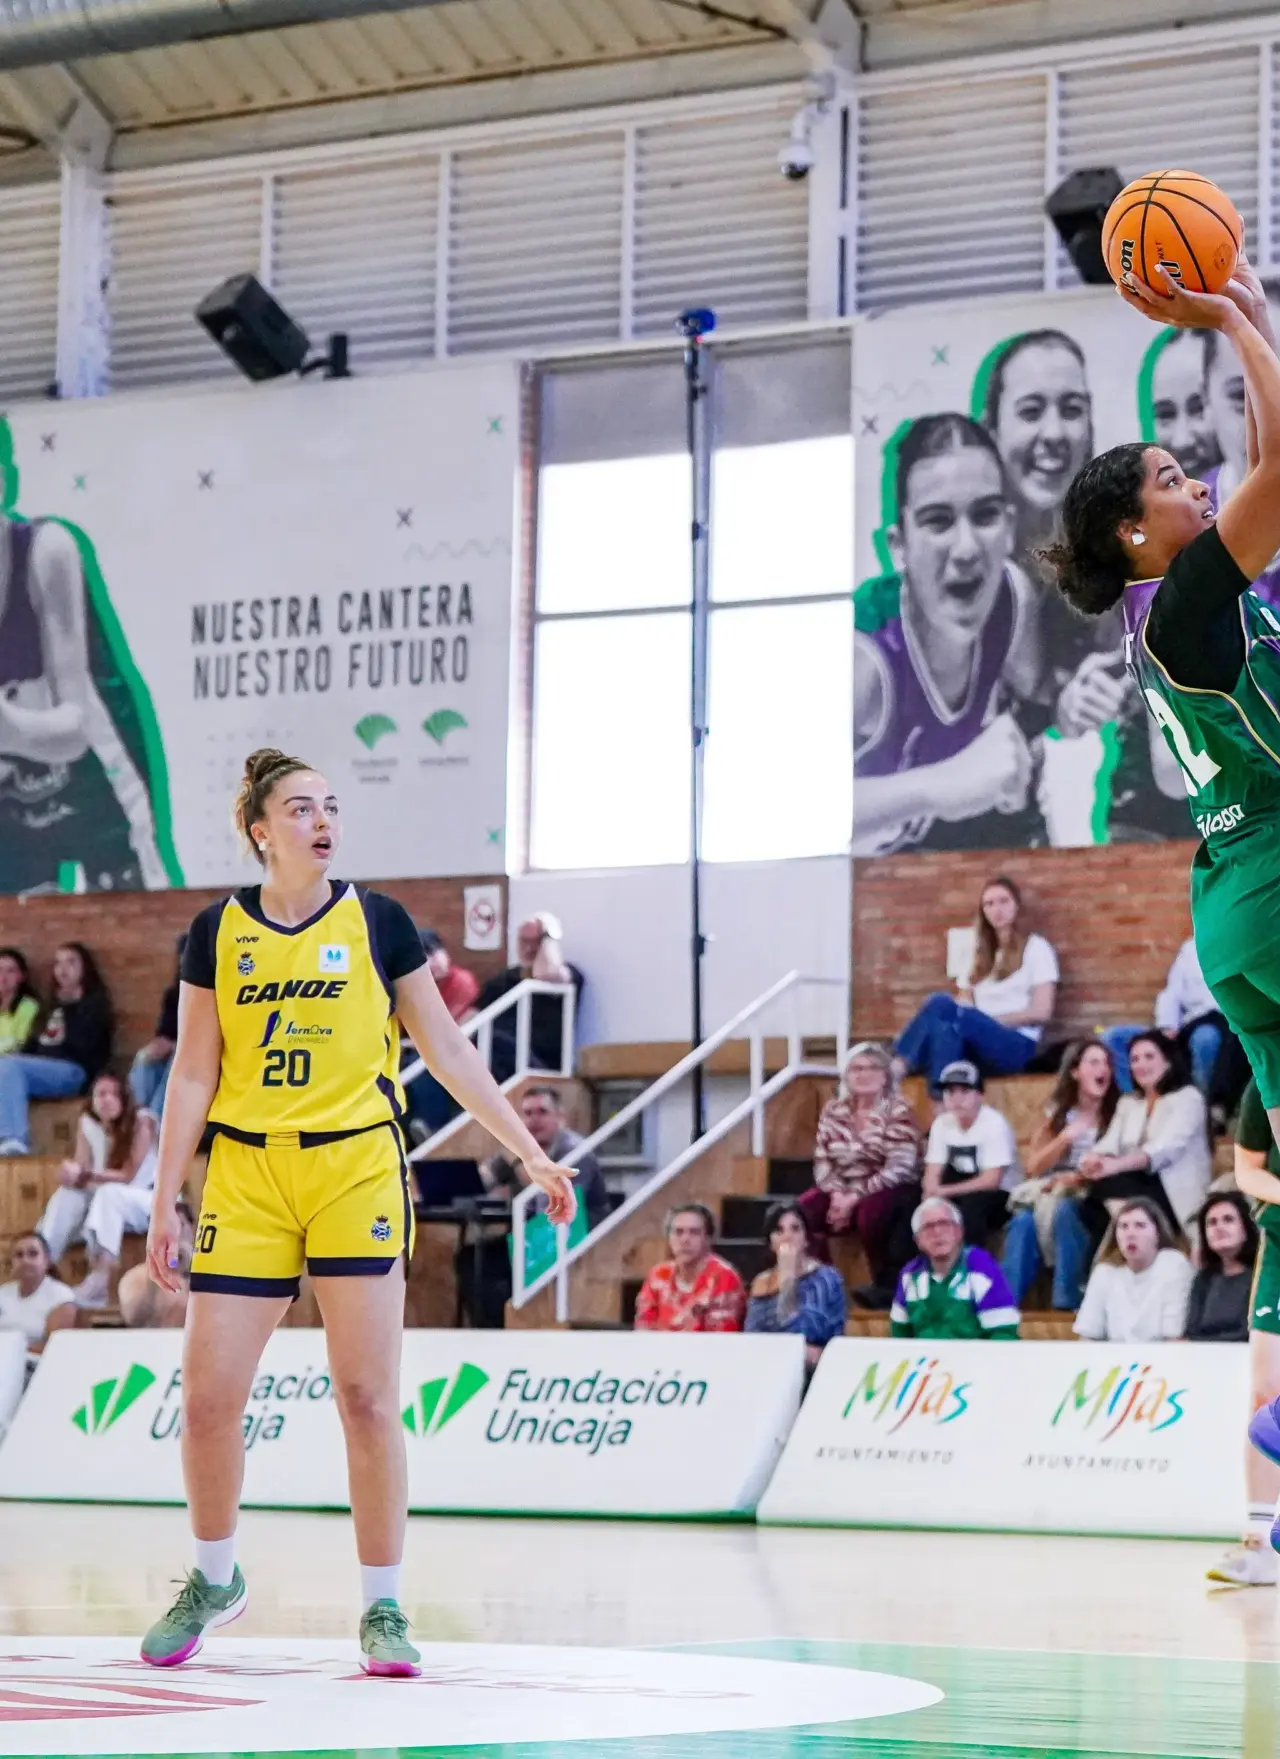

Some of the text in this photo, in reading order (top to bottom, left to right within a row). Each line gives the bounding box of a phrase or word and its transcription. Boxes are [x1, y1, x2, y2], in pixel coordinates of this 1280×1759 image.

[191, 581, 474, 645] NUESTRA CANTERA
[193, 634, 470, 700] NUESTRO FUTURO
[235, 935, 260, 944] vive
[235, 979, 349, 1005] CANOE
[262, 1049, 311, 1087] 20
[499, 1368, 709, 1406] Fundación
[842, 1357, 972, 1436] Mijas
[1051, 1362, 1190, 1442] Mijas
[485, 1407, 633, 1456] Unicaja
[815, 1446, 955, 1464] AYUNTAMIENTO
[1022, 1453, 1171, 1473] AYUNTAMIENTO
